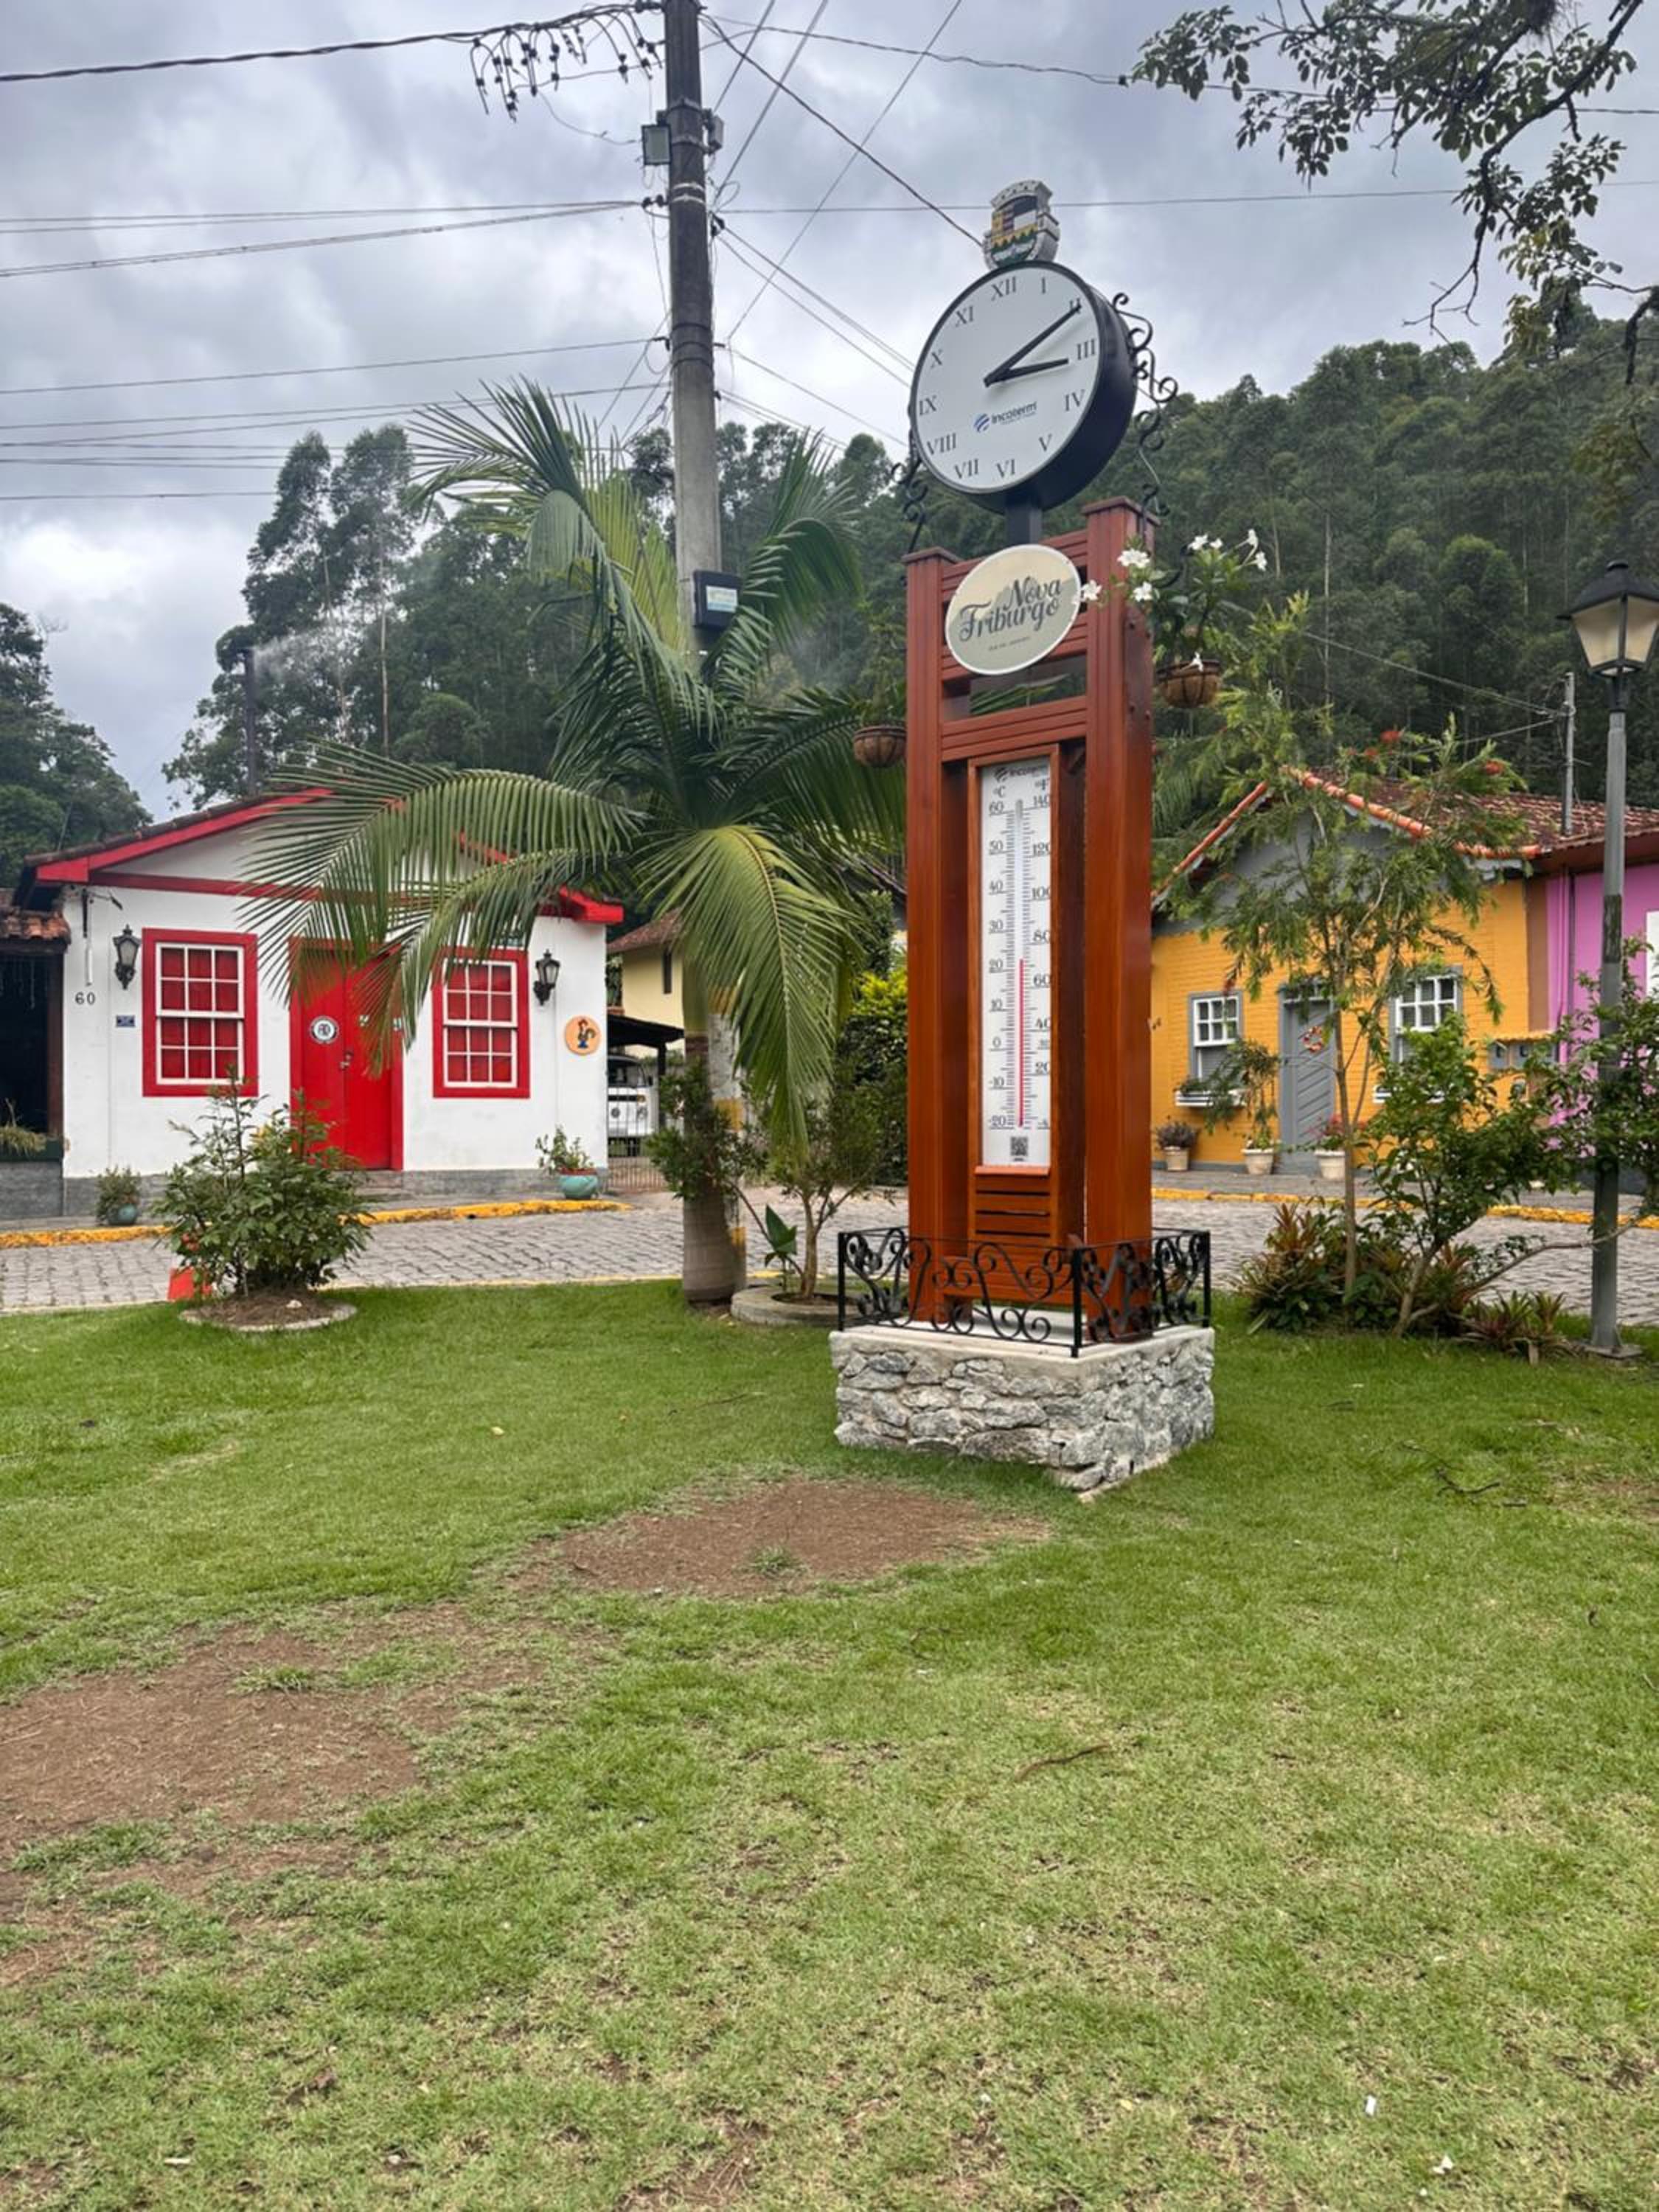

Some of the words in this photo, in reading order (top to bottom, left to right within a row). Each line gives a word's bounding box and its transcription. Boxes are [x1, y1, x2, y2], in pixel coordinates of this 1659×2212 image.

[991, 276, 1017, 301] XII
[955, 305, 975, 327] XI
[930, 349, 943, 369] X
[1077, 338, 1096, 361] III
[919, 394, 937, 416] IX
[1064, 389, 1085, 413] IV
[927, 434, 958, 456] VIII
[1038, 434, 1053, 453] V
[954, 459, 980, 481] VII
[995, 459, 1017, 479] VI
[1004, 576, 1062, 611] Nova
[959, 599, 1060, 642] Friburgo
[989, 801, 1004, 813] 60
[990, 839, 1004, 851] 50
[75, 991, 96, 1006] 60
[992, 1037, 1001, 1048] 0
